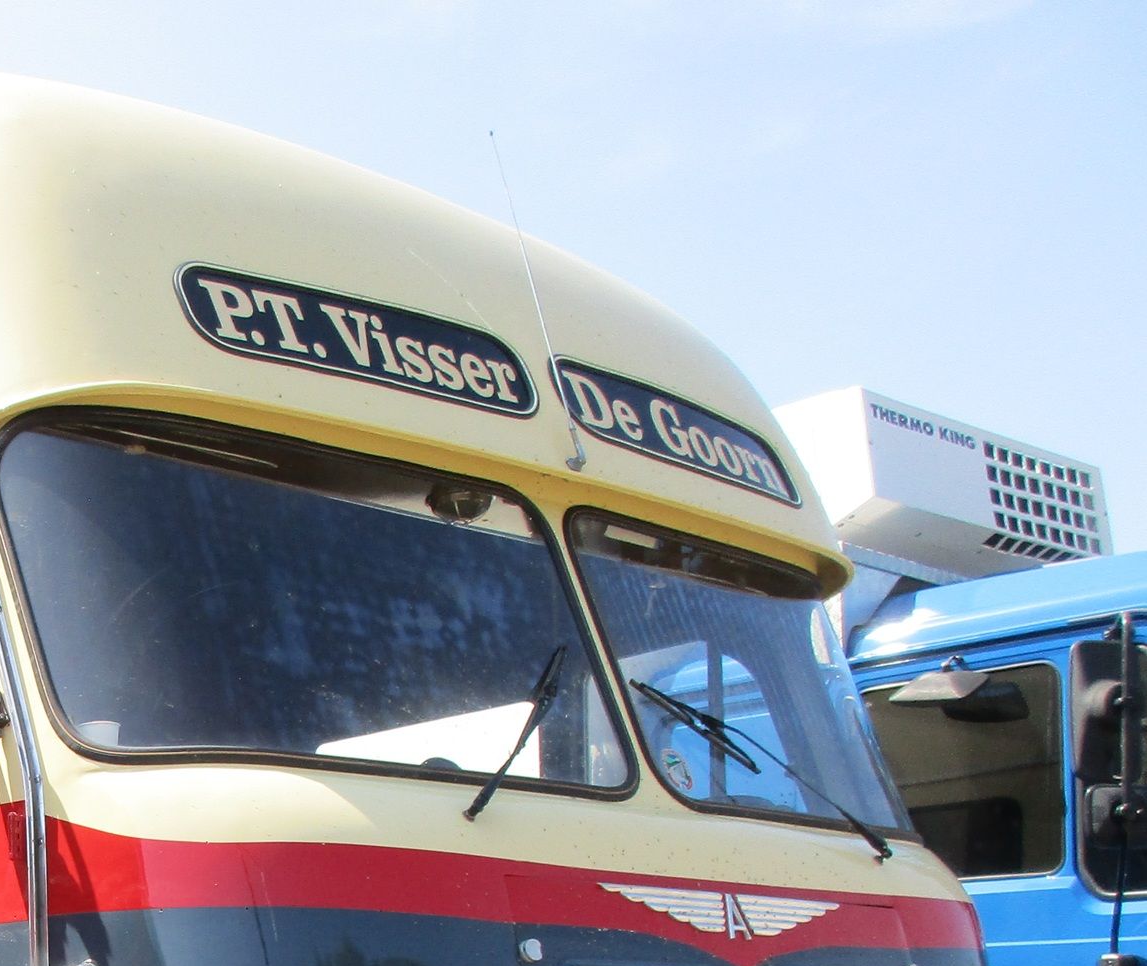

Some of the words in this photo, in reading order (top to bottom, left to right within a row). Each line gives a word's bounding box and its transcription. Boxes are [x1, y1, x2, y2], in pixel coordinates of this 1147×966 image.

[197, 279, 327, 358] P.T.
[320, 303, 519, 404] Visser
[562, 370, 643, 441] De
[650, 399, 790, 498] Goorn
[870, 403, 934, 436] THERMO
[939, 426, 976, 449] KING
